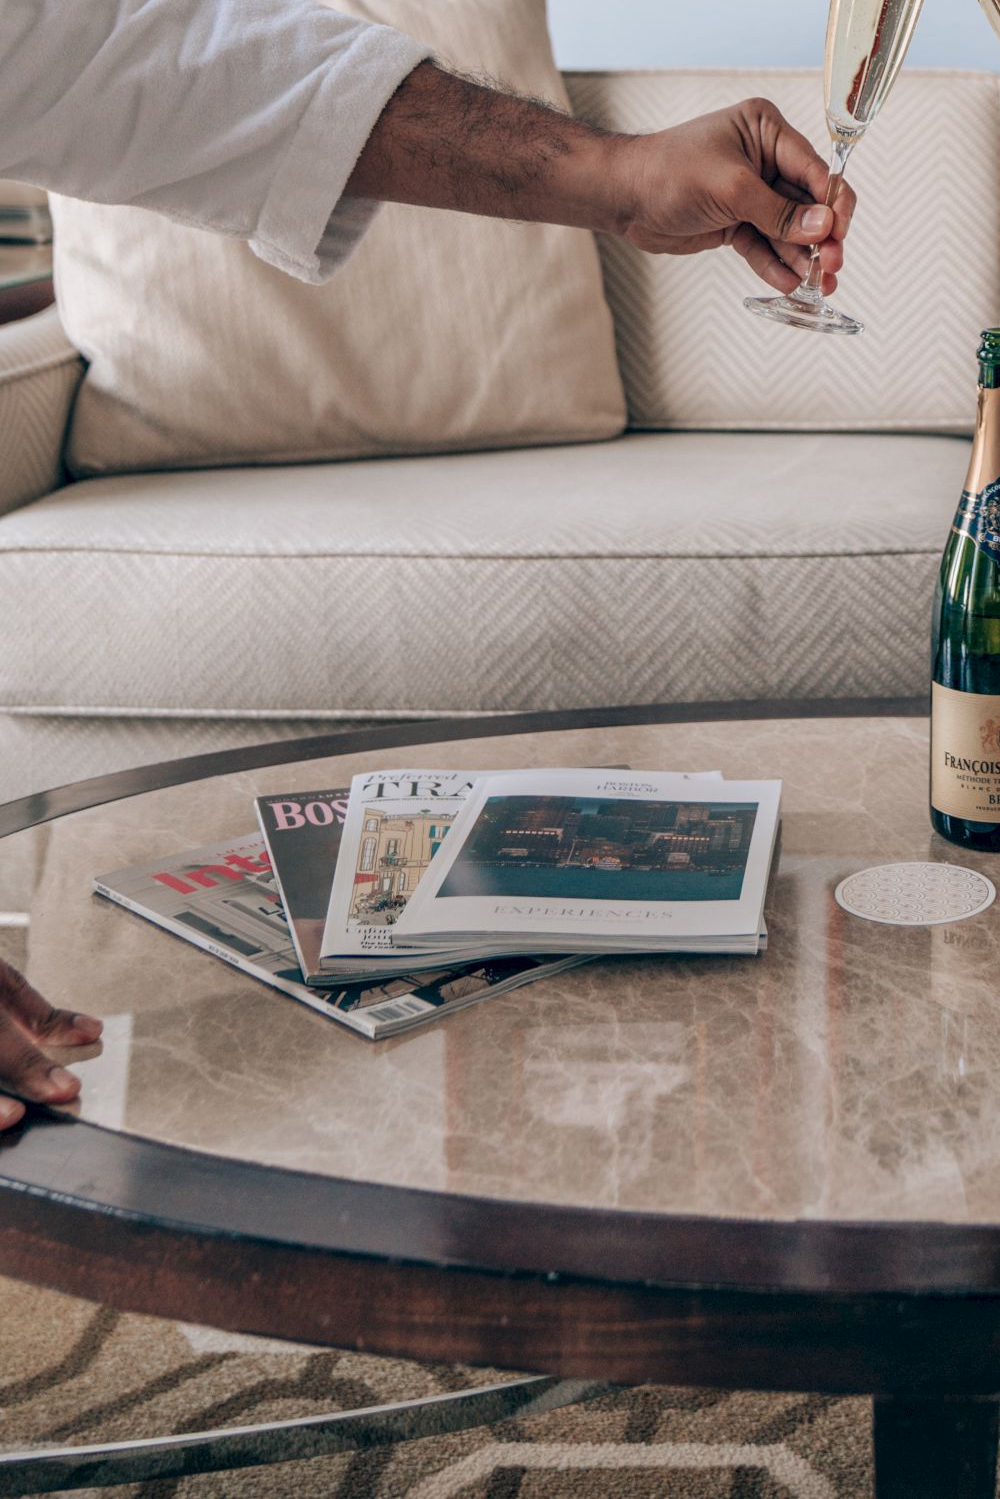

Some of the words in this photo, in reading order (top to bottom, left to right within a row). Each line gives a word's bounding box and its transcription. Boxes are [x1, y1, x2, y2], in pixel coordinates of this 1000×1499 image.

[956, 774, 991, 784] MÉTHODE
[961, 784, 991, 792] BLANC
[494, 905, 673, 918] EXPERIENCES
